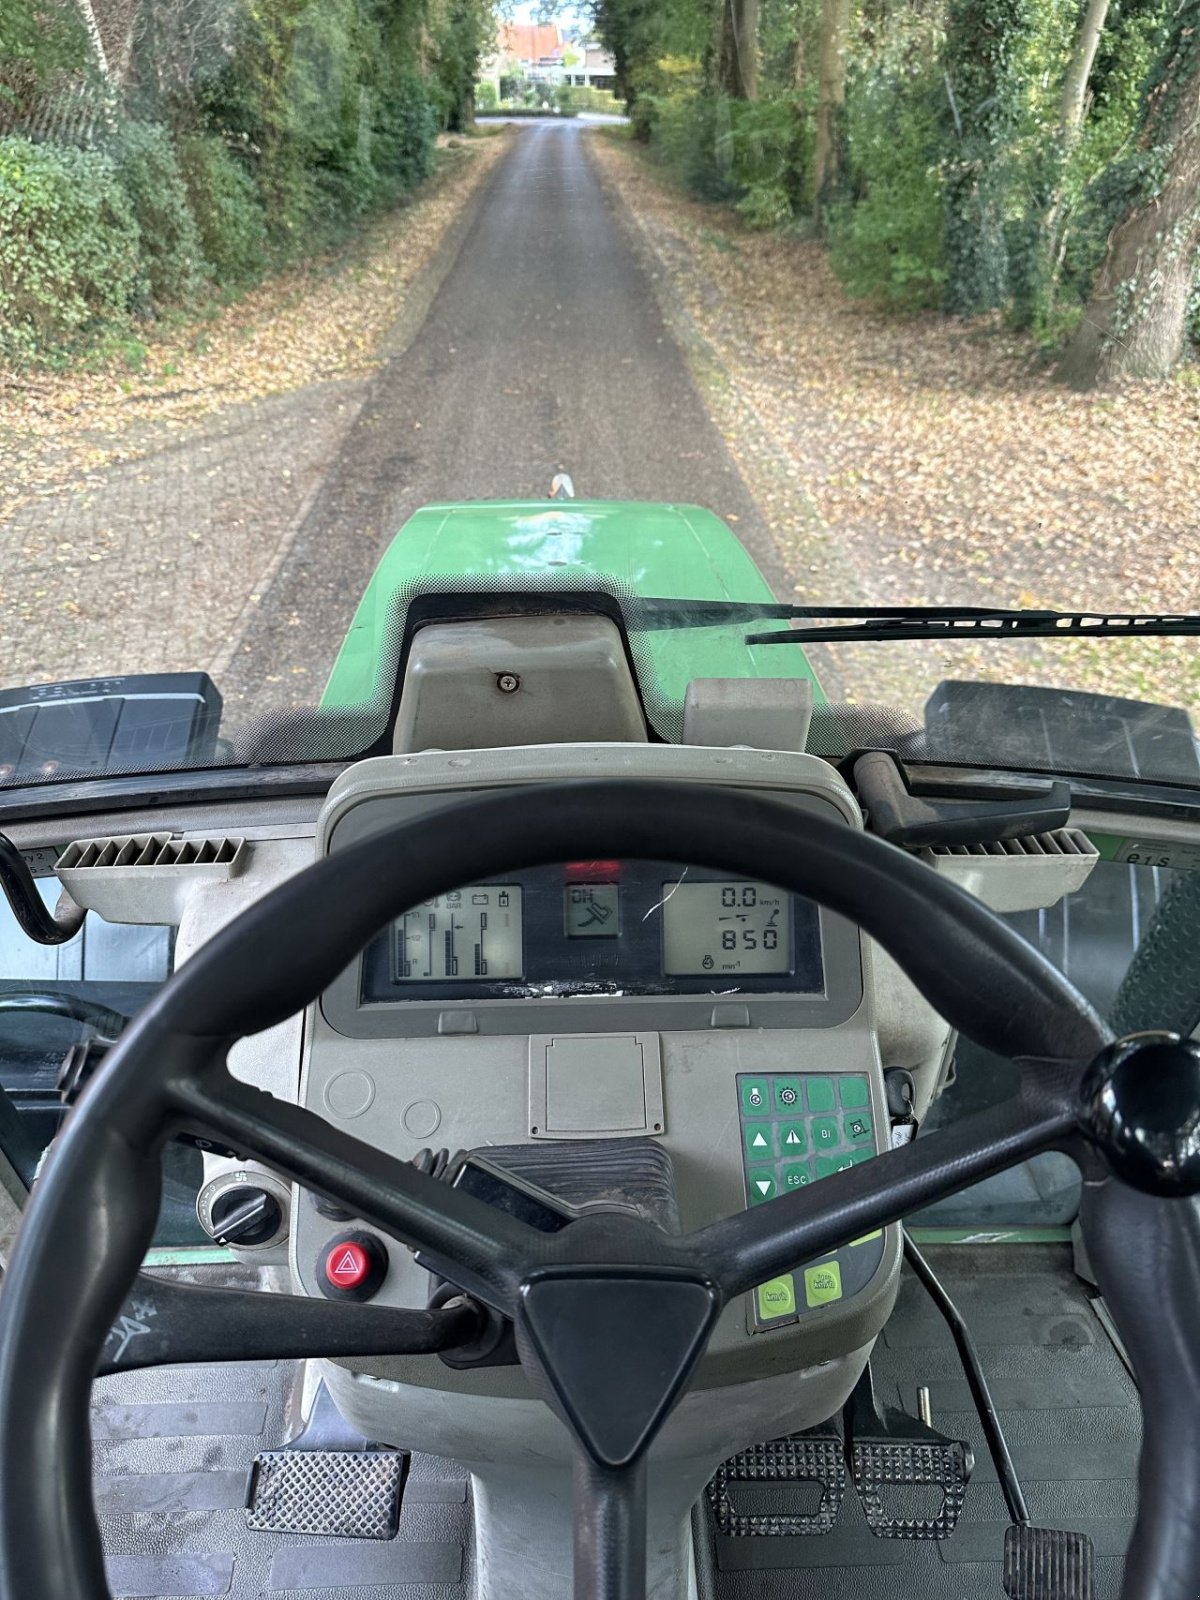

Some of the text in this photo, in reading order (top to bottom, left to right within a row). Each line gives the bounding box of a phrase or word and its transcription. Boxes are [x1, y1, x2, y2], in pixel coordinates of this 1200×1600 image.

[721, 887, 780, 908] 0.0 km/h
[722, 929, 778, 950] 850
[787, 1175, 807, 1185] ESC
[765, 1290, 789, 1302] km/h
